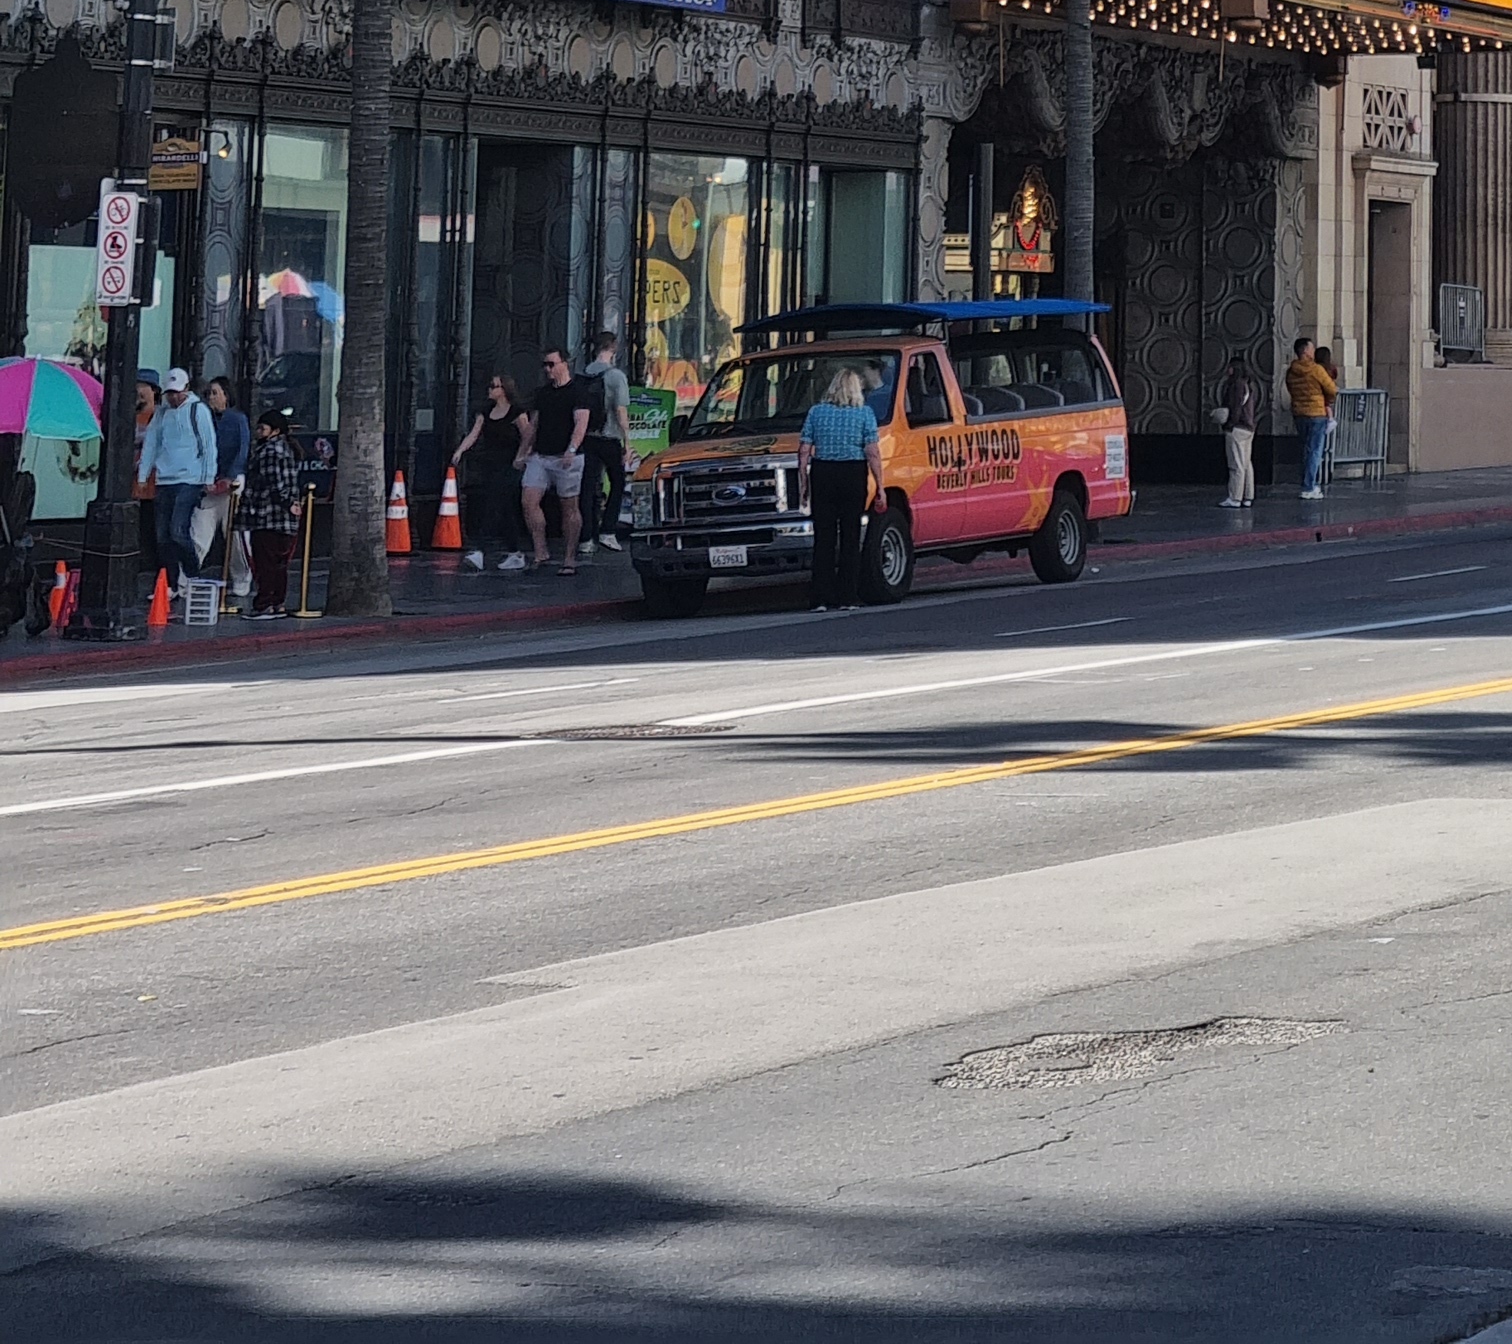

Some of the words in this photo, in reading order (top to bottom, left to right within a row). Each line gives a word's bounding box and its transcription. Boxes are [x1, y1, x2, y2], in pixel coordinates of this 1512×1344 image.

[926, 428, 1021, 469] HOLLYWOOD
[937, 471, 968, 490] BEVERLY
[971, 469, 990, 486] HILLS
[992, 465, 1015, 482] TOURS
